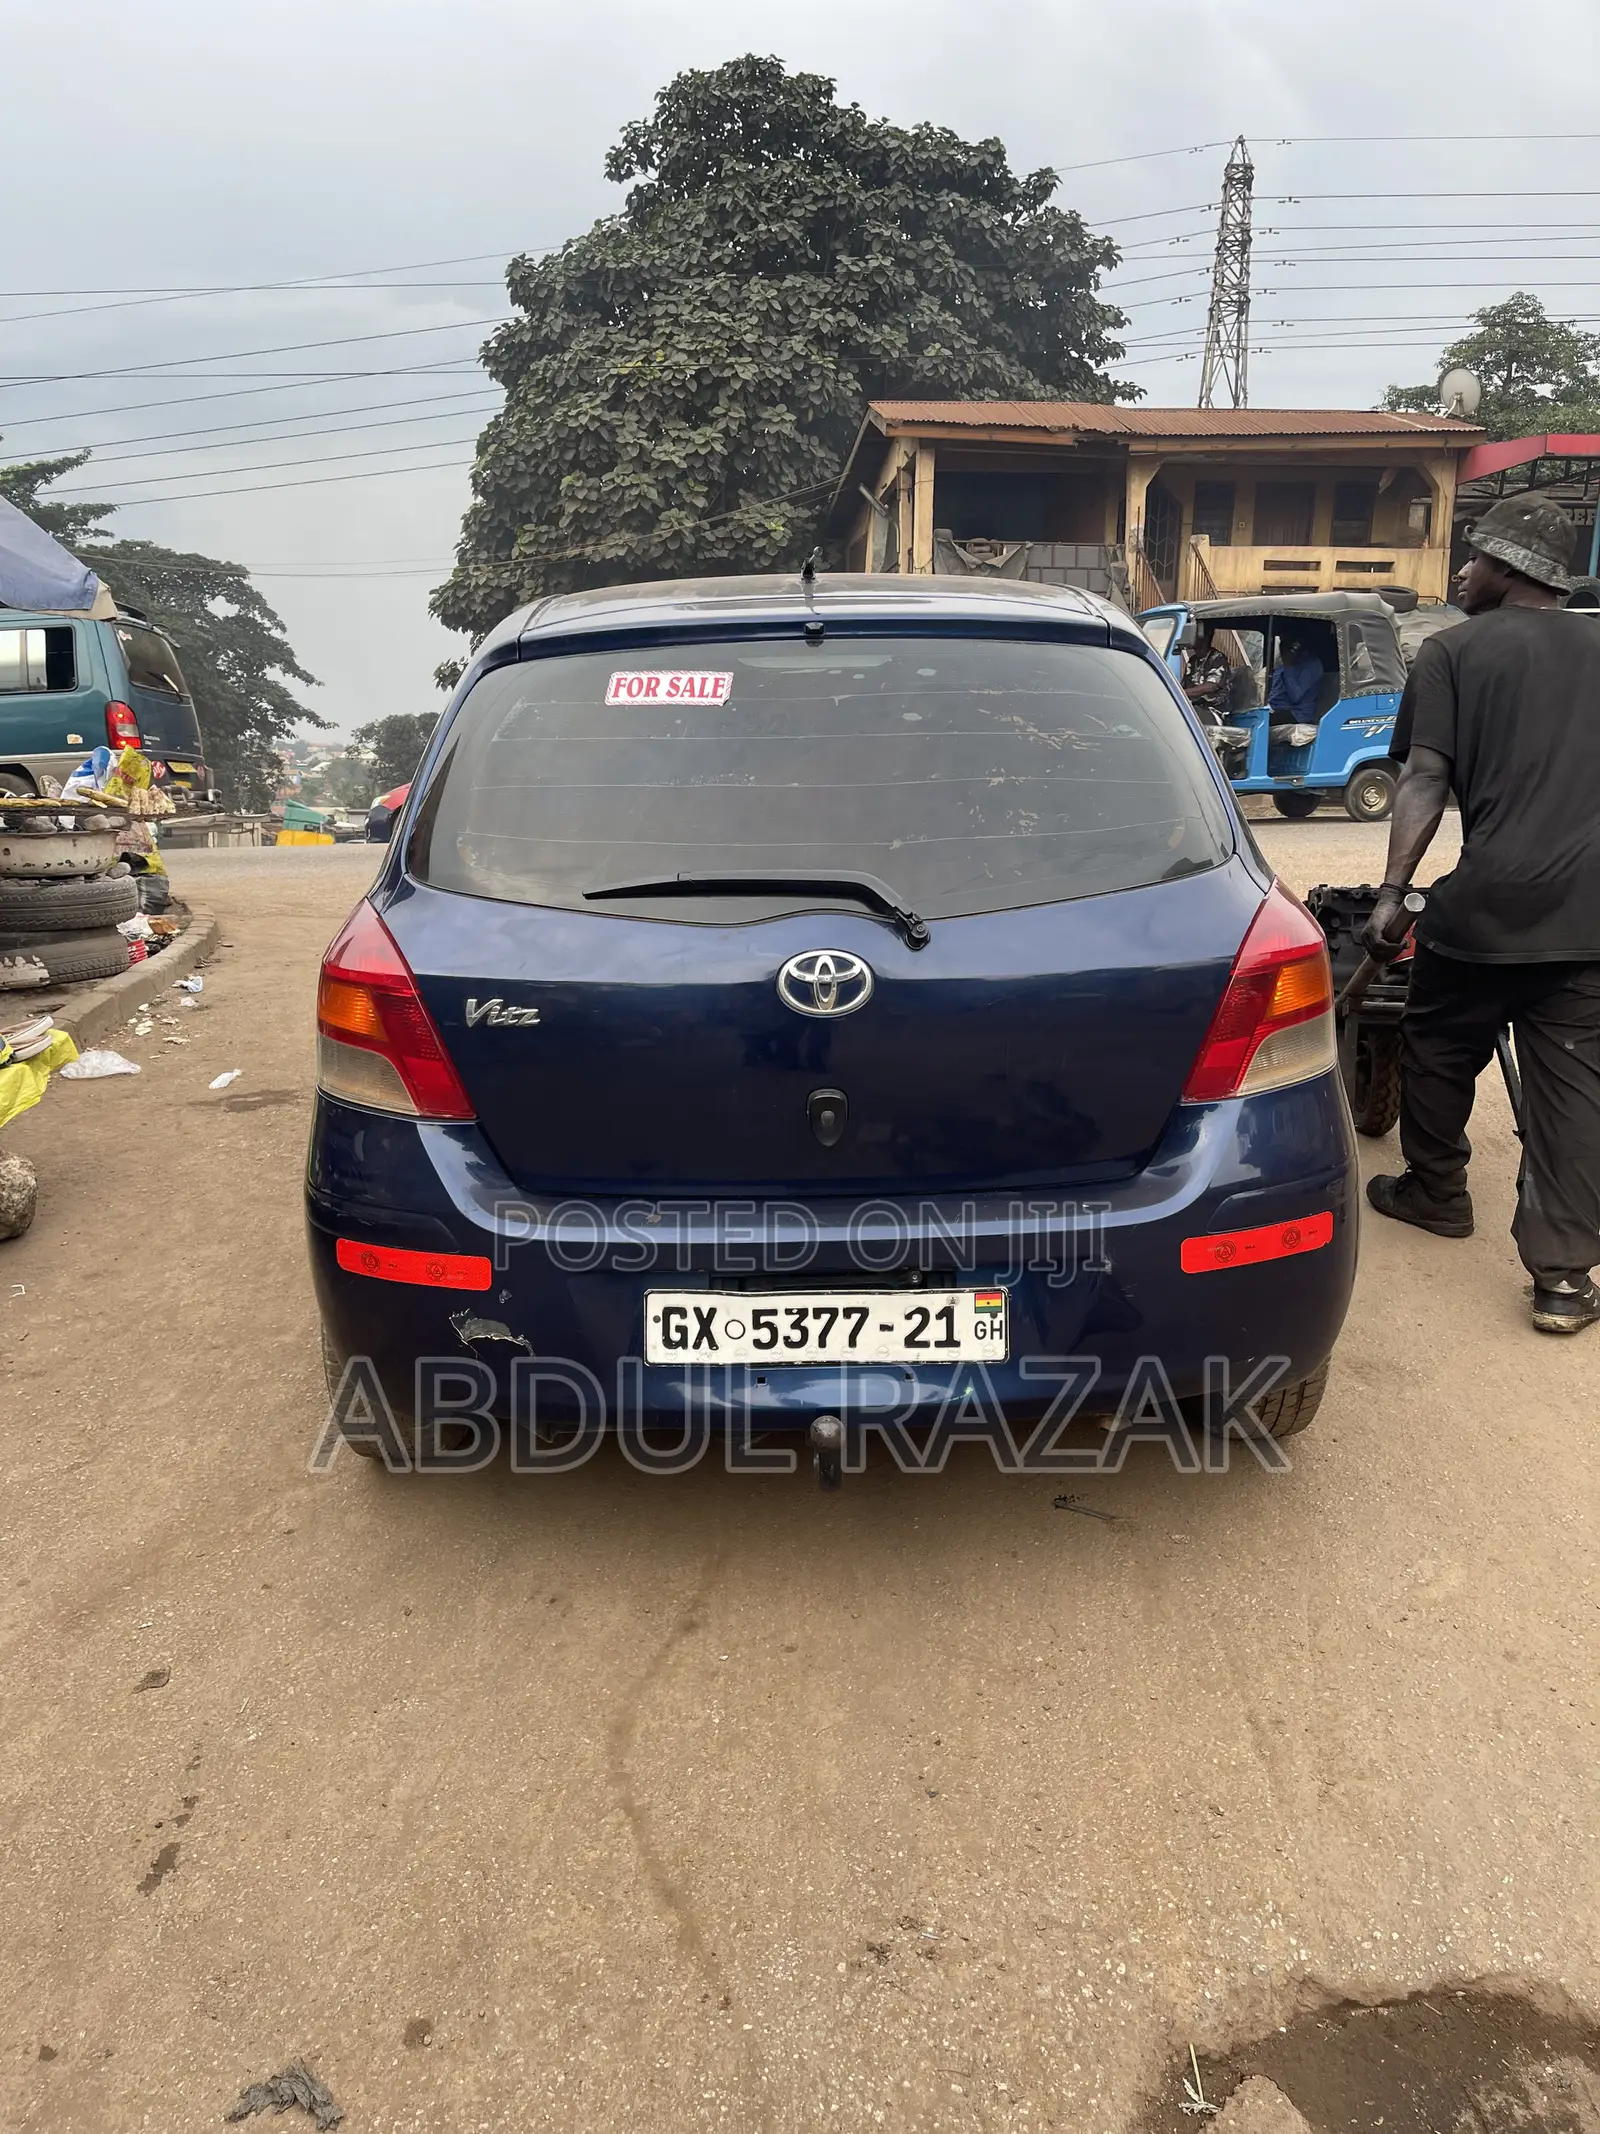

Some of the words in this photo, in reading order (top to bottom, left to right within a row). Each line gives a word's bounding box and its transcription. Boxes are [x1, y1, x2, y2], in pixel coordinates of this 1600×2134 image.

[612, 677, 661, 698] FOR
[665, 676, 727, 699] SALE
[464, 998, 541, 1028] Vitz
[661, 1306, 720, 1351] GX
[974, 1319, 1003, 1340] GH
